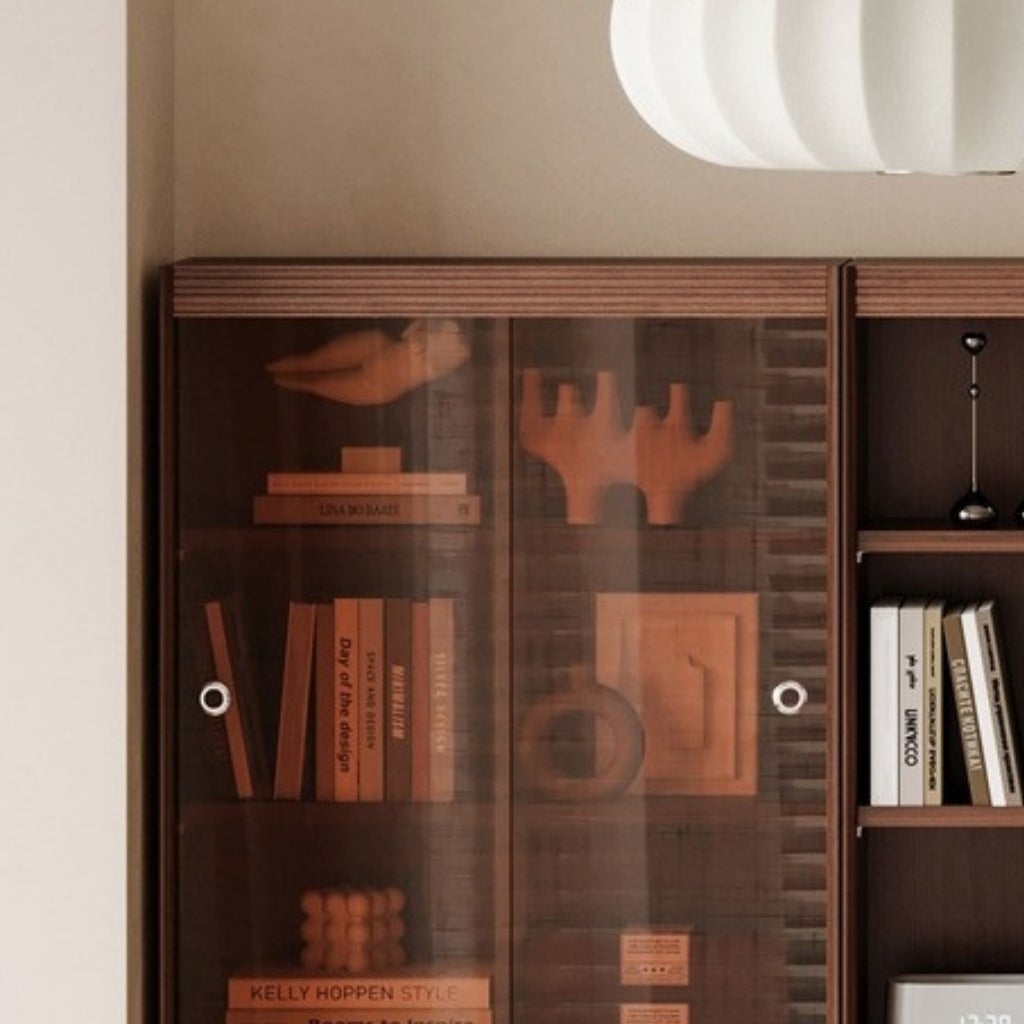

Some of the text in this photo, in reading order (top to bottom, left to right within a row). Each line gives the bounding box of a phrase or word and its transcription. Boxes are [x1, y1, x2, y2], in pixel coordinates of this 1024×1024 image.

[337, 637, 352, 772] Day of the design
[252, 985, 458, 1000] KELLY HOPPEN STYLE
